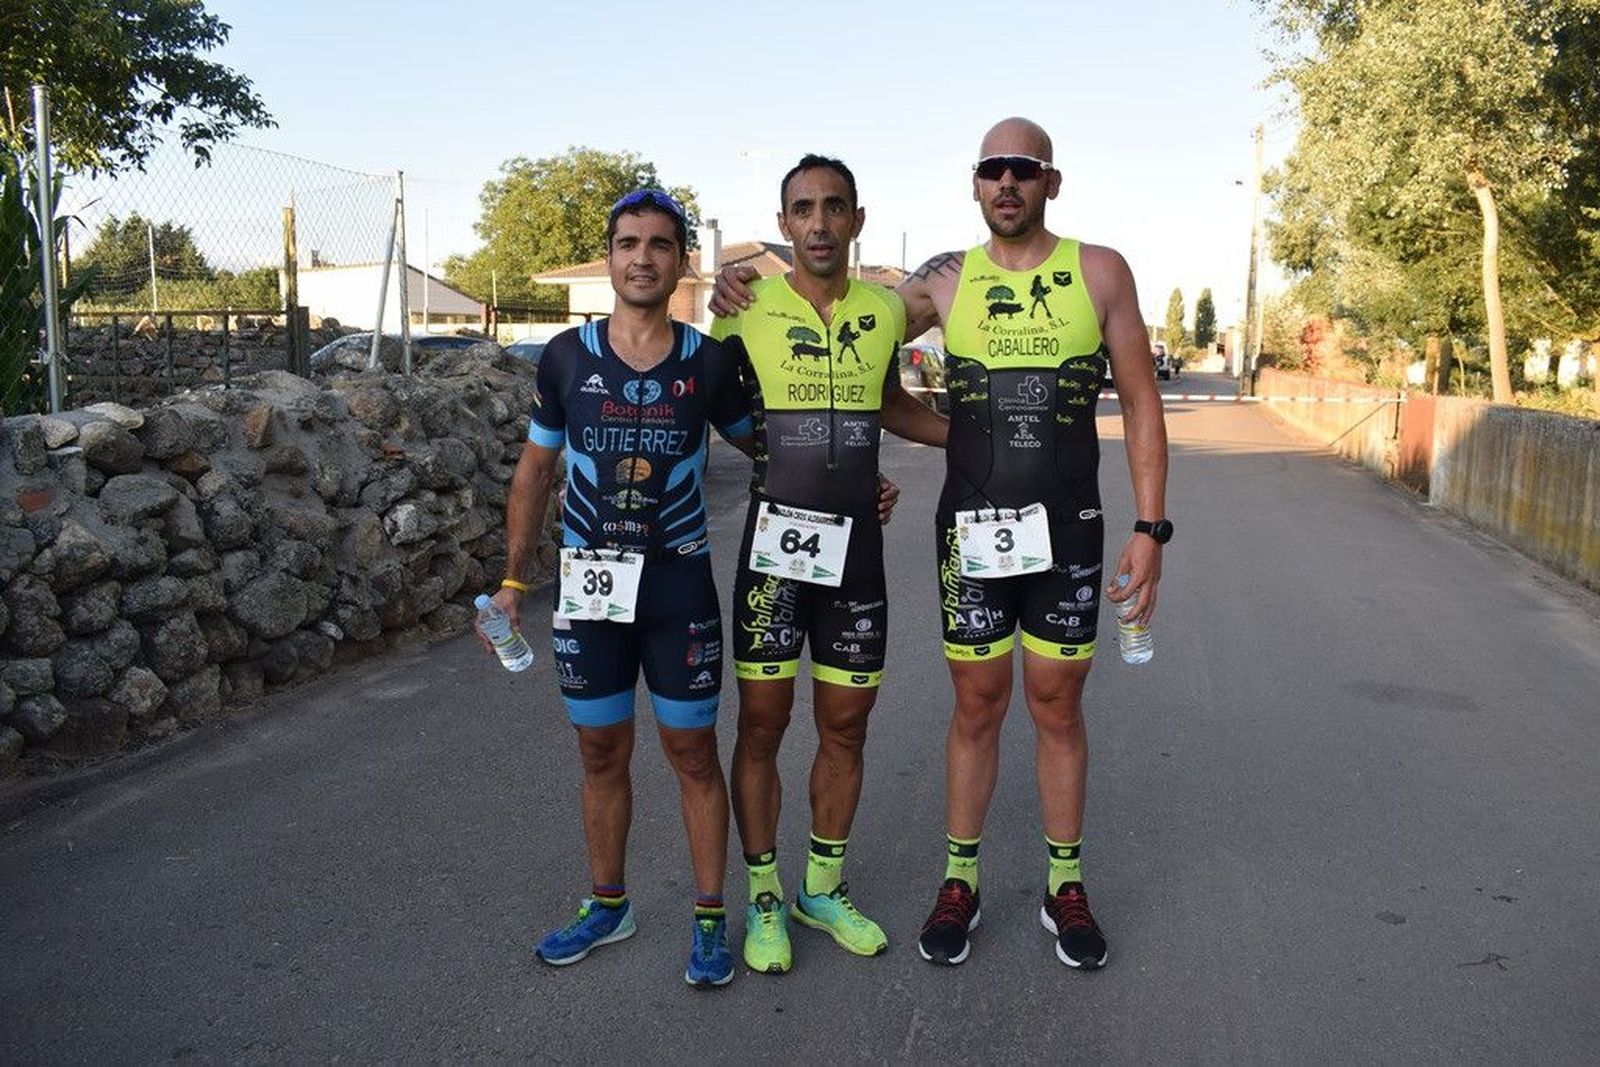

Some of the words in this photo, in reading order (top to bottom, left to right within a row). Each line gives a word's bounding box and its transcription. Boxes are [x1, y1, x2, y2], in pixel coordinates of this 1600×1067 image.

[977, 319, 990, 332] La
[992, 325, 1047, 336] Corralina,
[987, 338, 1060, 357] CABALLERO
[780, 359, 794, 372] La
[788, 383, 865, 403] RODRIGUEZ
[843, 420, 870, 428] AMTEL
[1008, 415, 1041, 423] AMTEL
[582, 426, 689, 456] GUTIERREZ
[1009, 440, 1042, 448] TELECO
[779, 527, 821, 559] 64
[994, 527, 1016, 554] 3
[582, 568, 614, 597] 39
